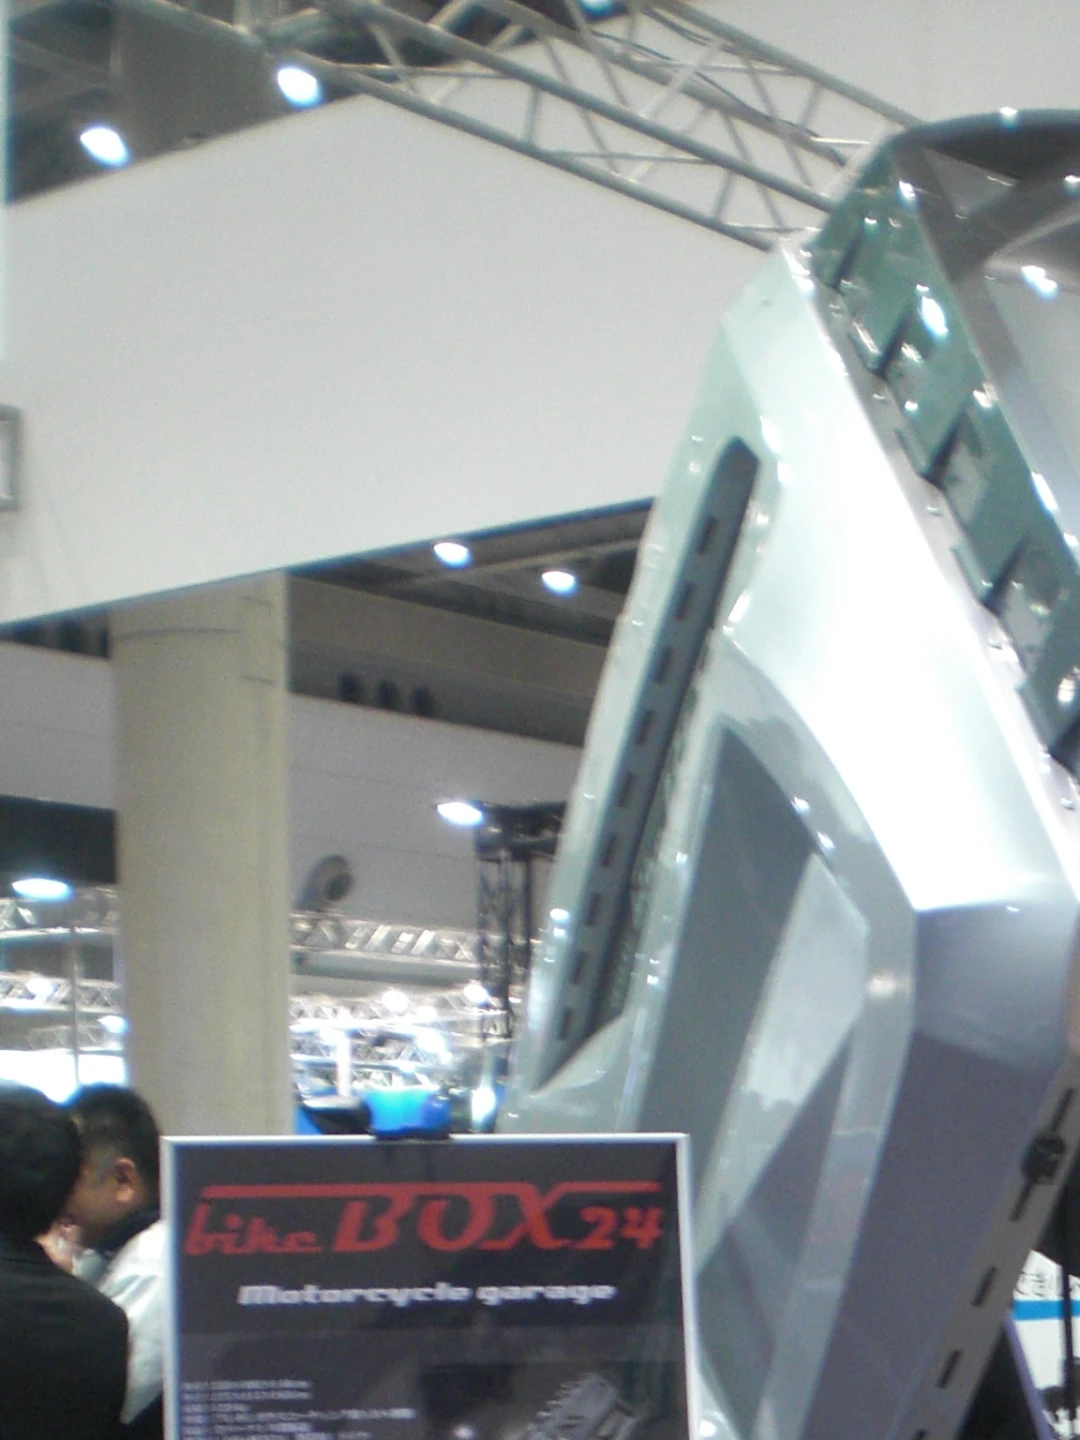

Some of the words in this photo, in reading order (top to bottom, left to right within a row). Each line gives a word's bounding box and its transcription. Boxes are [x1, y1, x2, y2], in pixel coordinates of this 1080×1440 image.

[184, 1202, 324, 1255] bike
[236, 1282, 473, 1307] Motorcycle
[475, 1285, 617, 1306] garage
